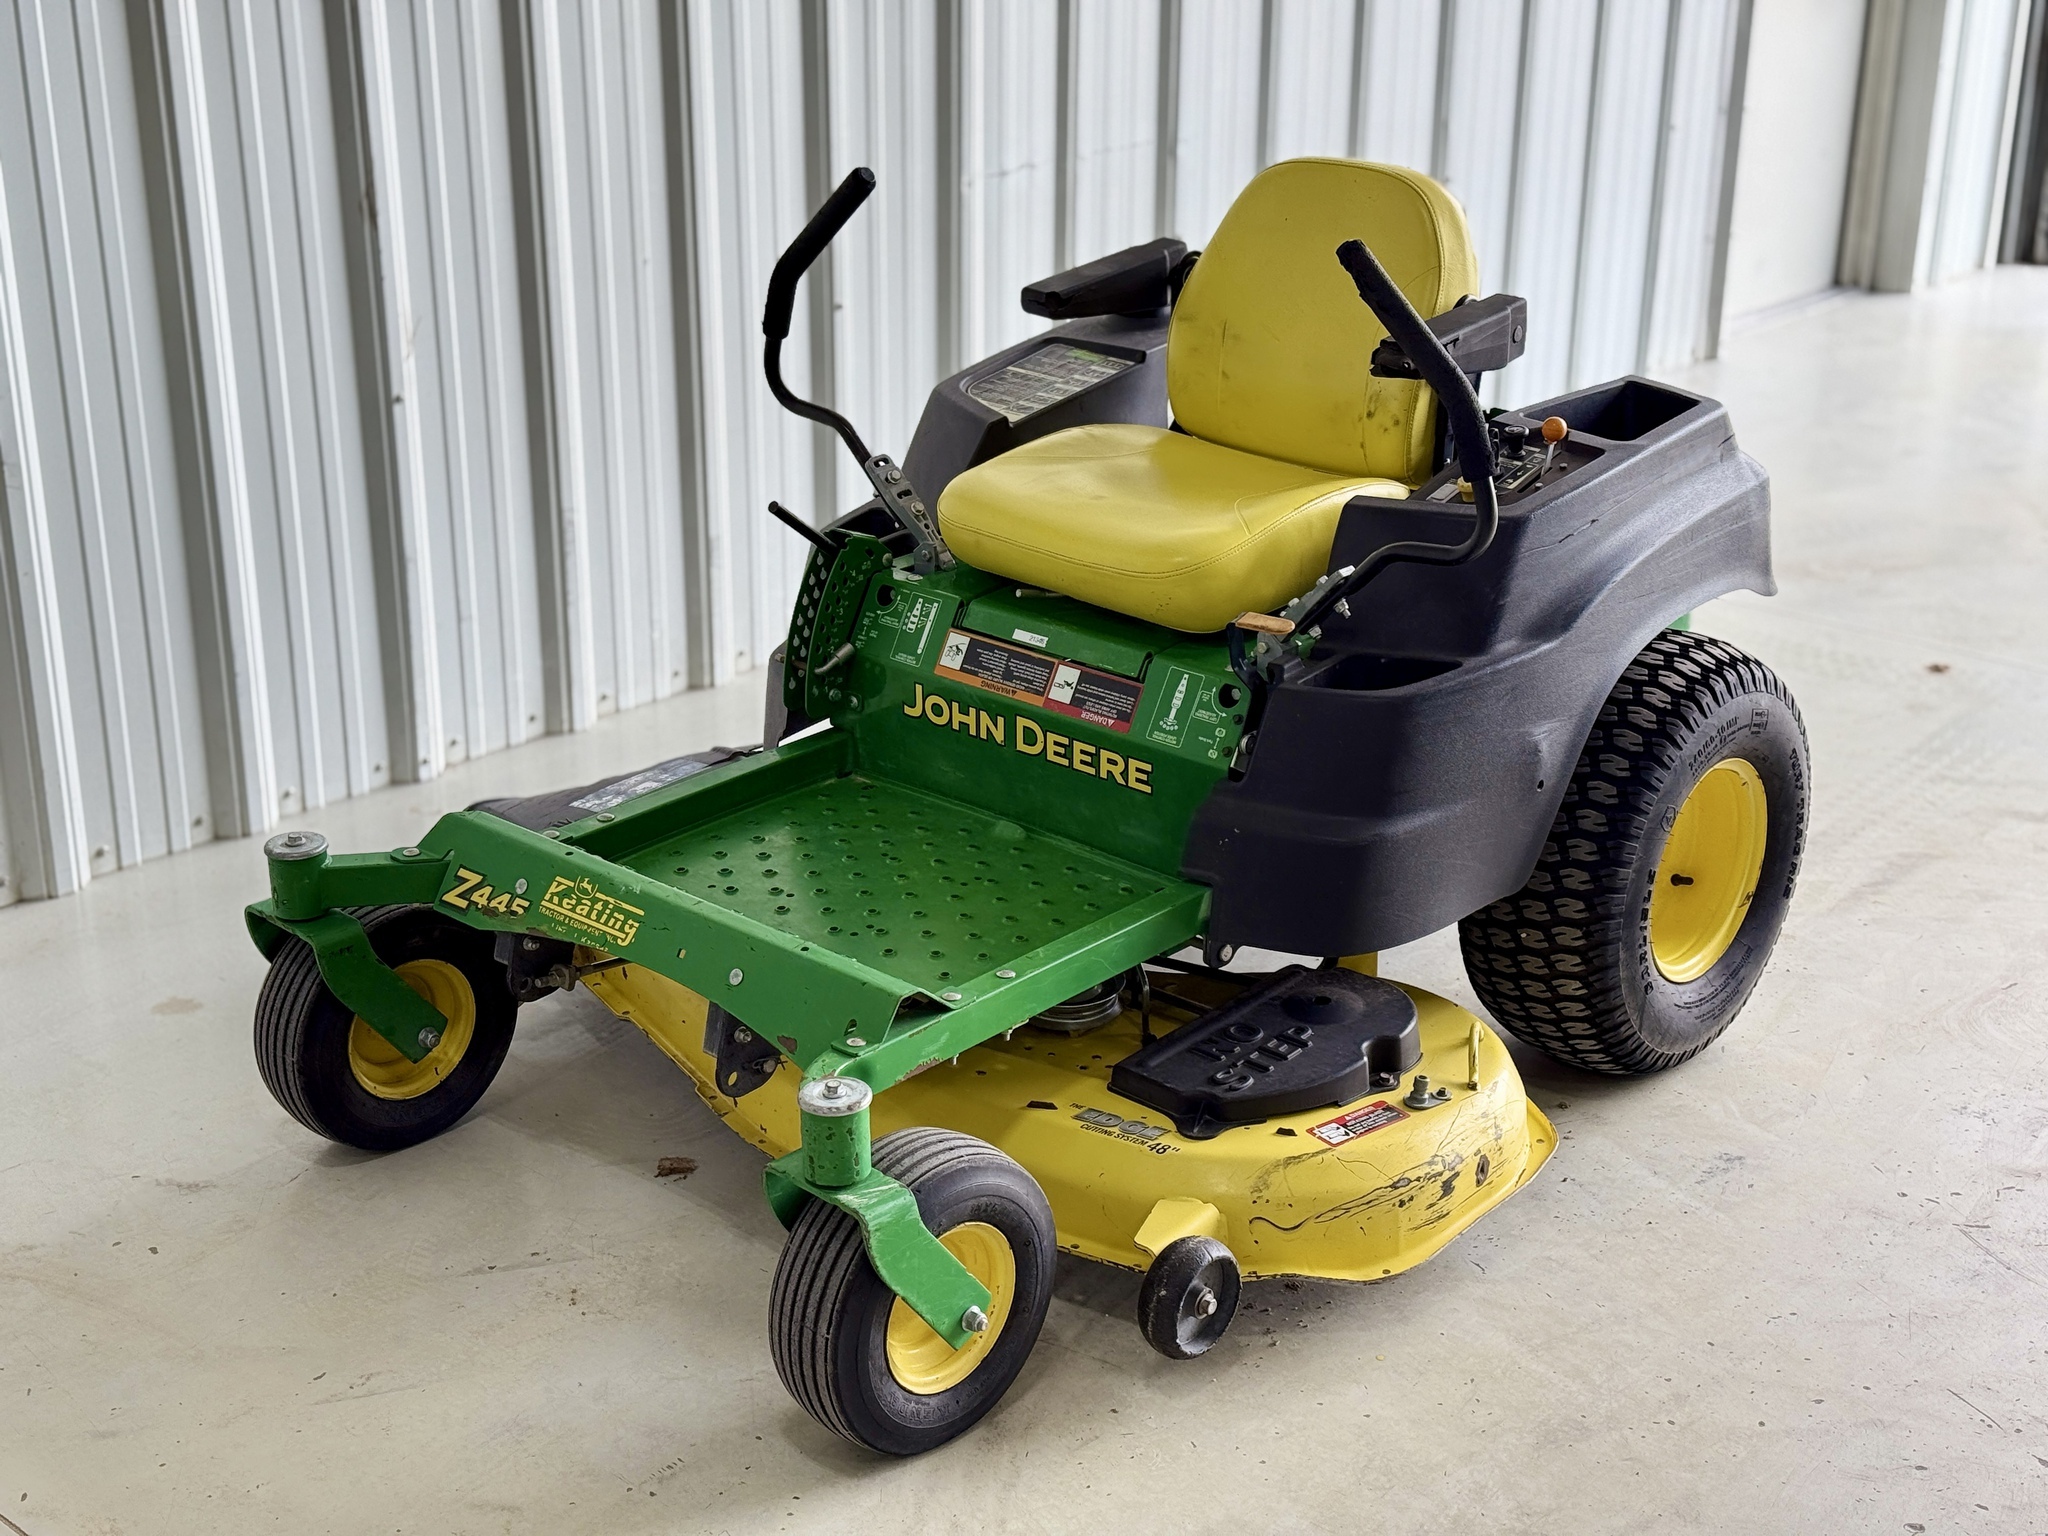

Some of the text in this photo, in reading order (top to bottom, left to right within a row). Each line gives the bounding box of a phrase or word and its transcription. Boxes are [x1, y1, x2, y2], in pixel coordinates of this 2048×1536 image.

[980, 680, 1011, 695] WARNING
[1080, 710, 1108, 725] DANGER
[903, 683, 1004, 746] JOHN
[1015, 715, 1153, 794] DEERE
[441, 866, 533, 919] Z445
[538, 905, 564, 923] TRACTOR
[564, 917, 570, 925] &
[543, 880, 640, 947] Keating
[1191, 1023, 1265, 1063] NO
[1209, 1023, 1315, 1092] STEP
[1069, 1102, 1087, 1112] THE
[1071, 1107, 1171, 1142] EDGE
[1080, 1124, 1181, 1156] CUTTING SYSTEM 48"
